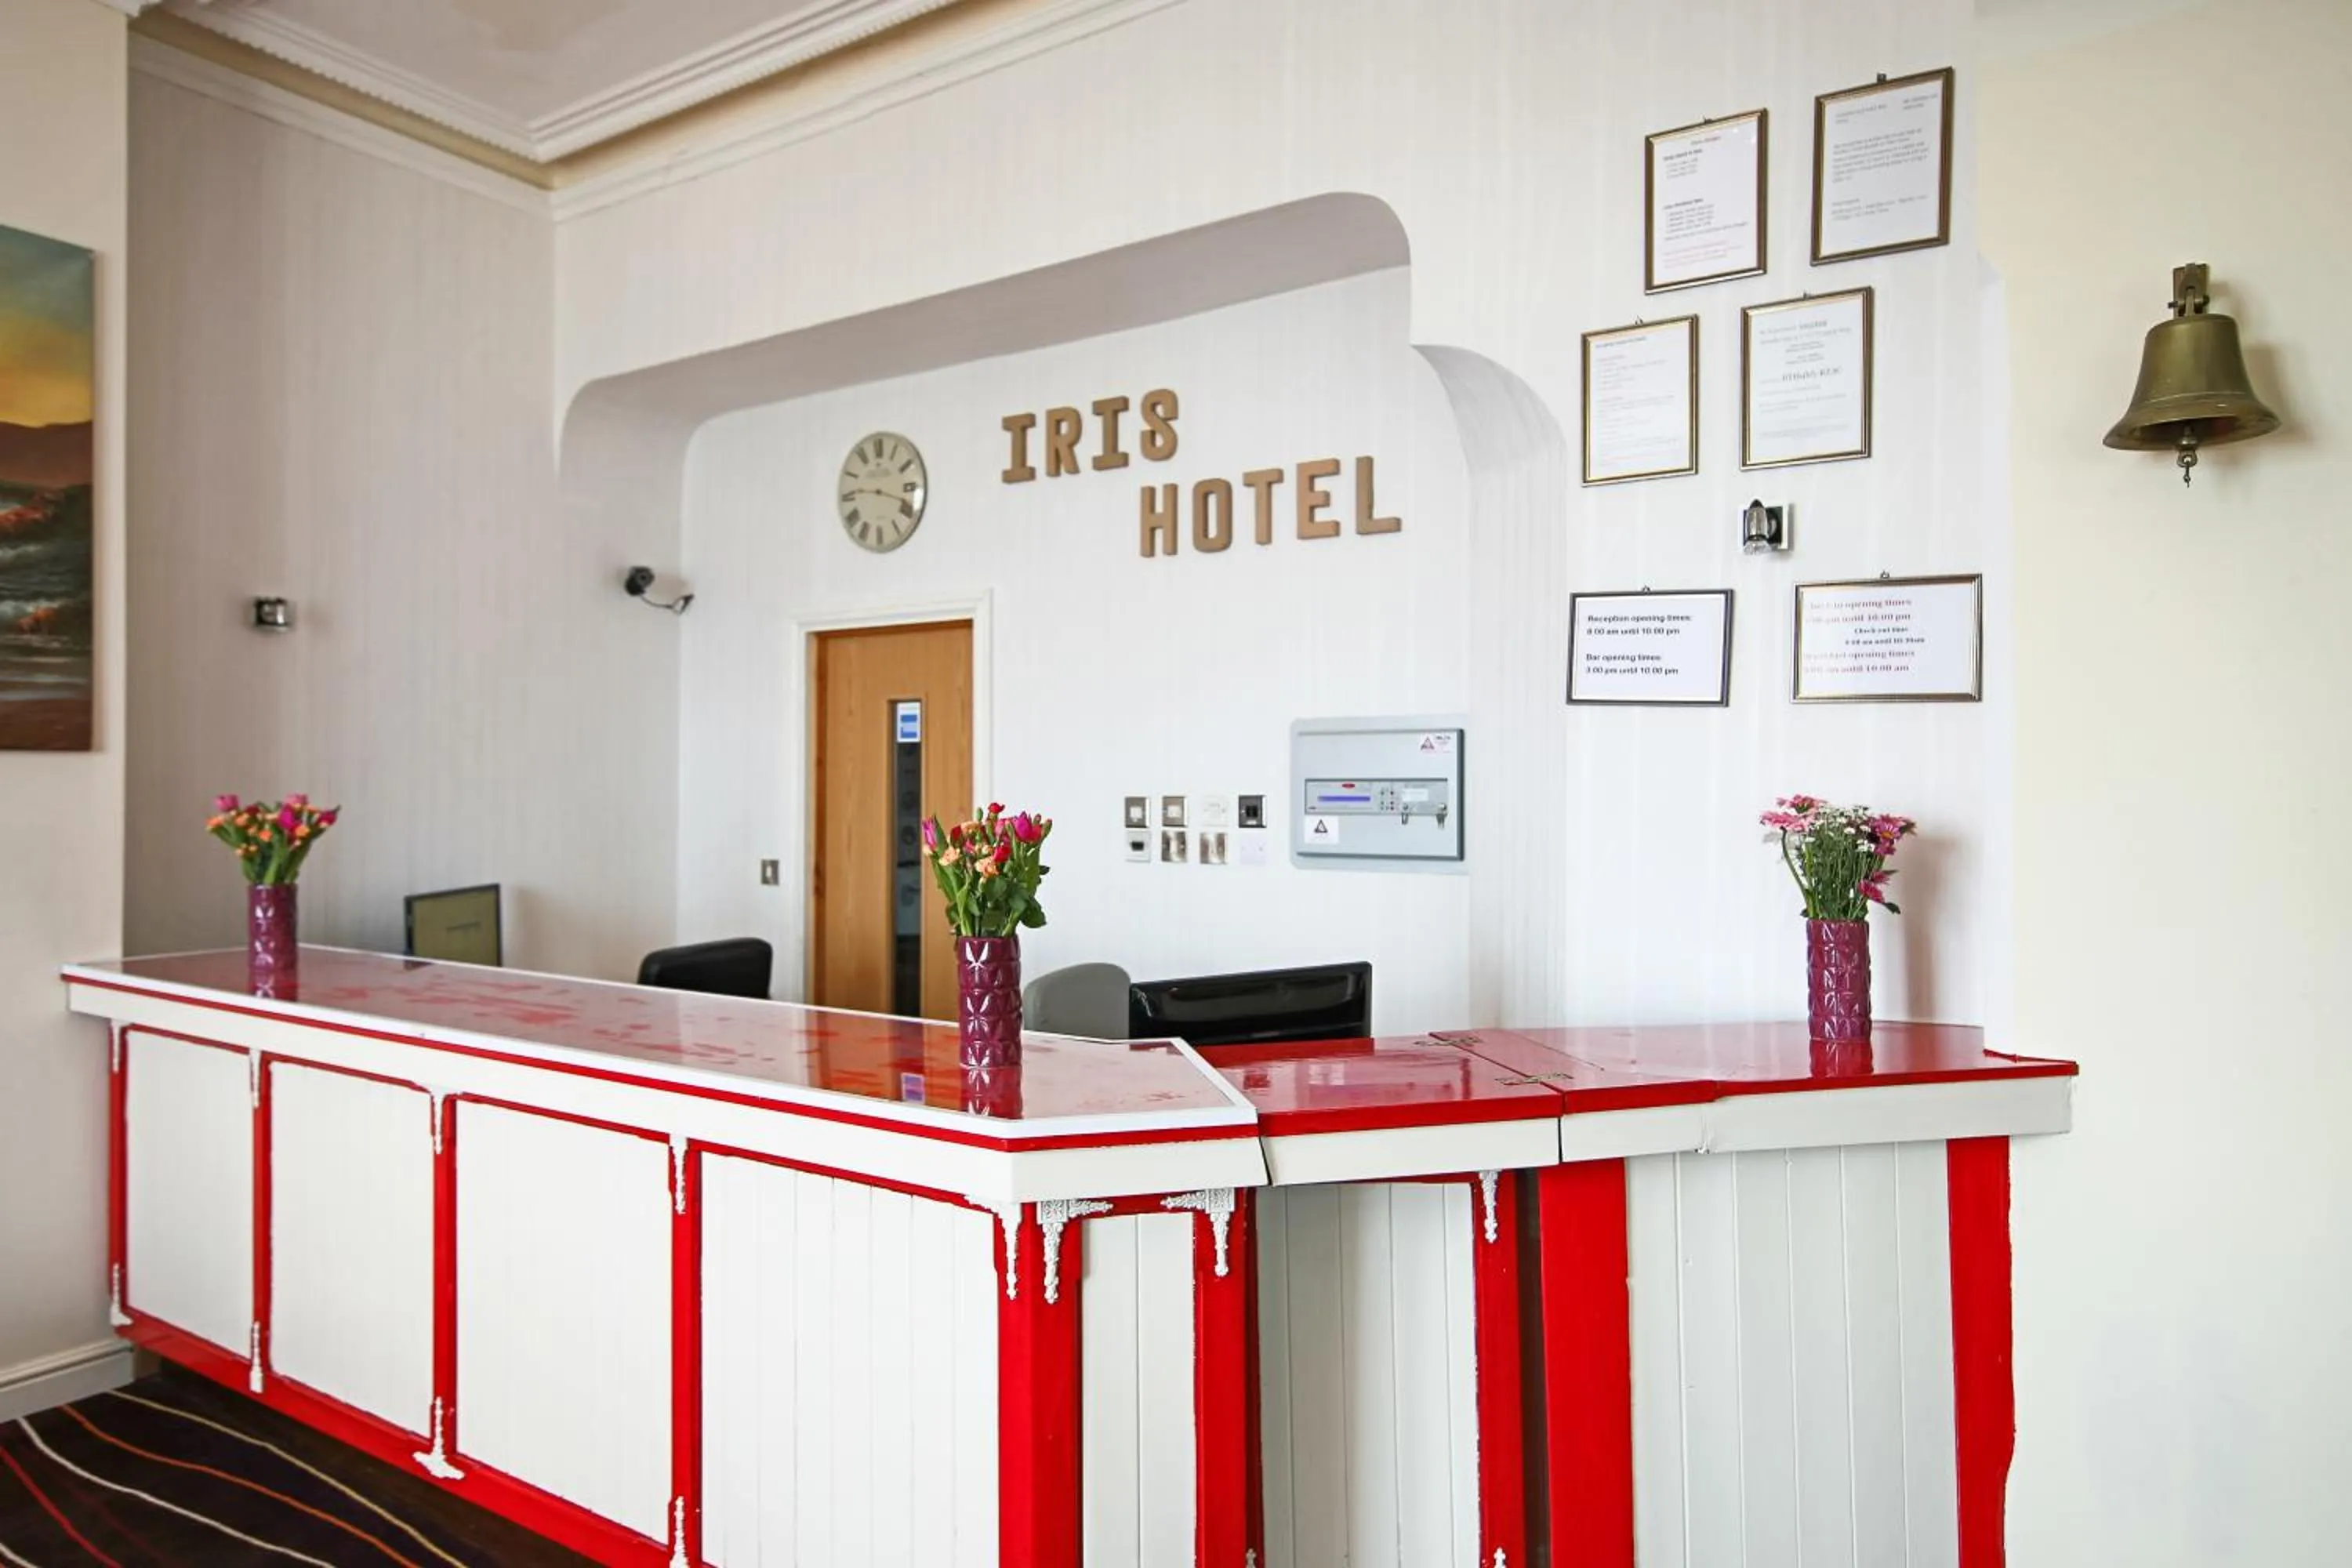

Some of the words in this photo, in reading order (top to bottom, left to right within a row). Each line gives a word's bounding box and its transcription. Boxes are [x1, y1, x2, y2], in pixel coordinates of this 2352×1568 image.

[1002, 388, 1178, 484] IRIS
[1140, 456, 1402, 558] HOTEL
[1588, 614, 1630, 625] Reception
[1631, 615, 1666, 625] opening
[1666, 628, 1681, 637] pm
[1585, 652, 1601, 662] Bar
[1602, 653, 1636, 663] opening
[1664, 667, 1679, 677] pm
